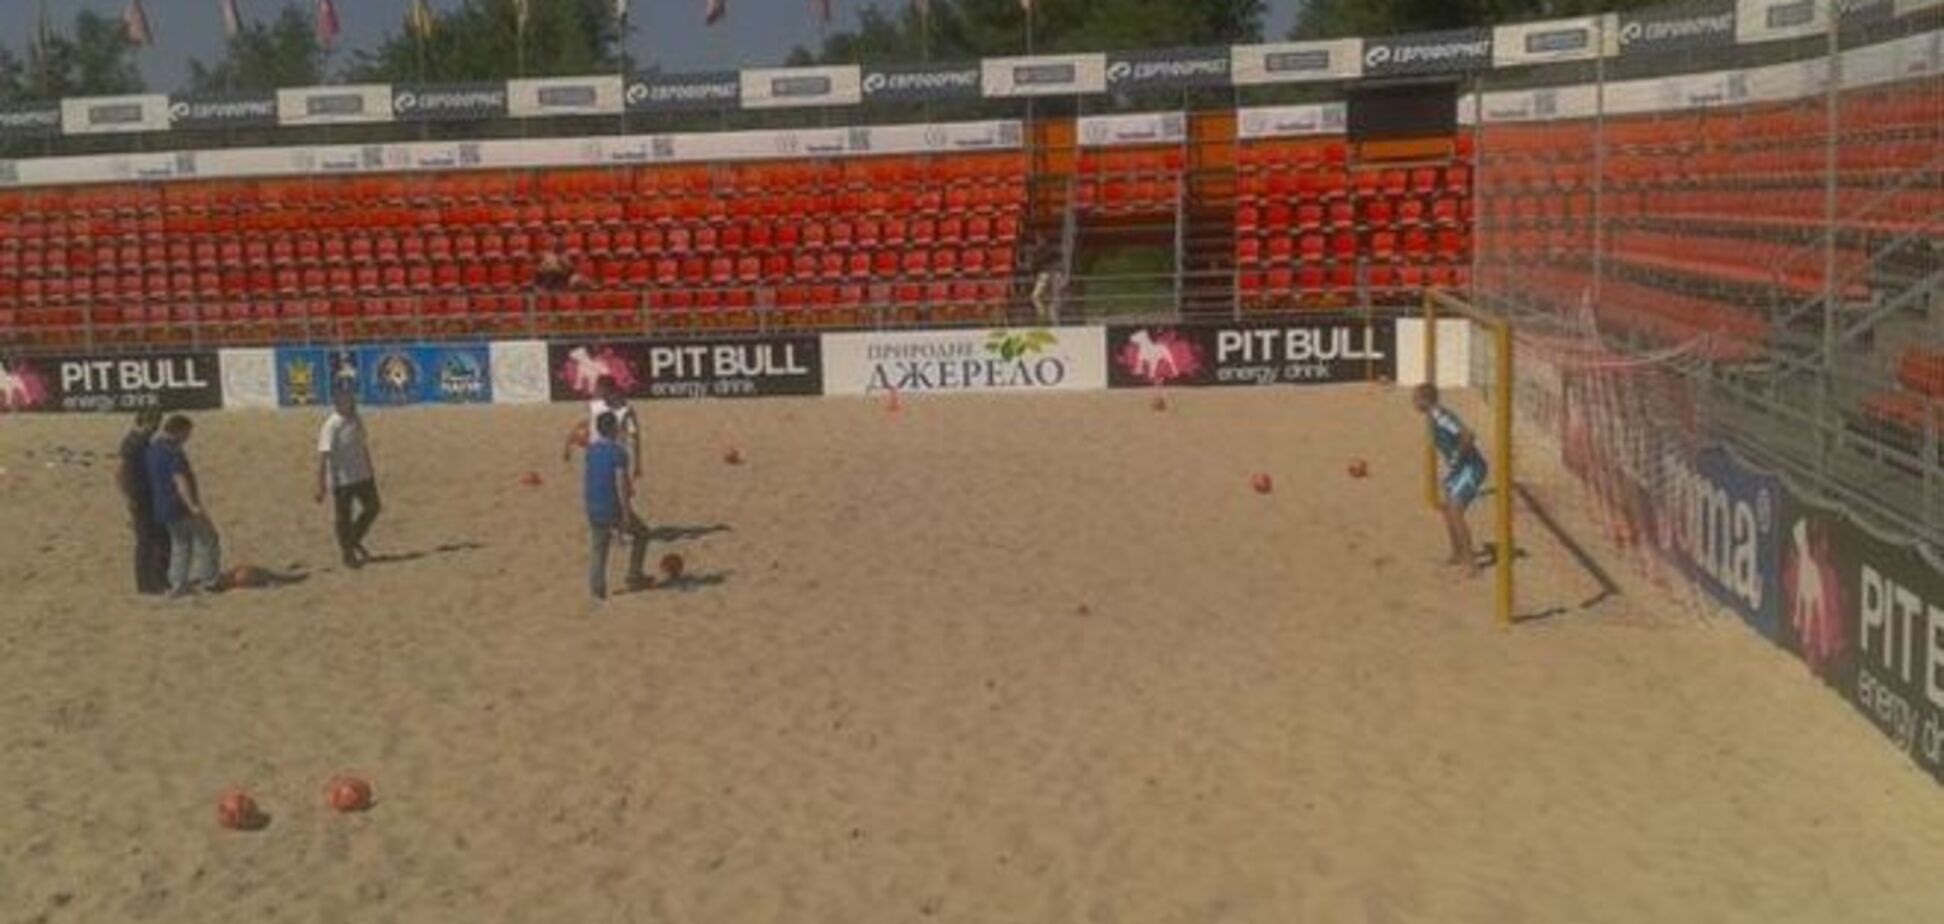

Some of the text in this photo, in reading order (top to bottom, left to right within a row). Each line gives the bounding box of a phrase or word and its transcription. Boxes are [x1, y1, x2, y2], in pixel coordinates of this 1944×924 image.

[650, 344, 808, 377] PIT BULL
[1218, 327, 1385, 362] PIT BULL
[60, 358, 207, 392] PIT BULL
[651, 379, 756, 397] energy drink
[866, 358, 1065, 394] ДЖЕРЕЛО
[1218, 362, 1331, 385] energy drink
[62, 395, 113, 410] energy
[1860, 563, 1923, 684] PIT
[1857, 668, 1918, 752] energy
